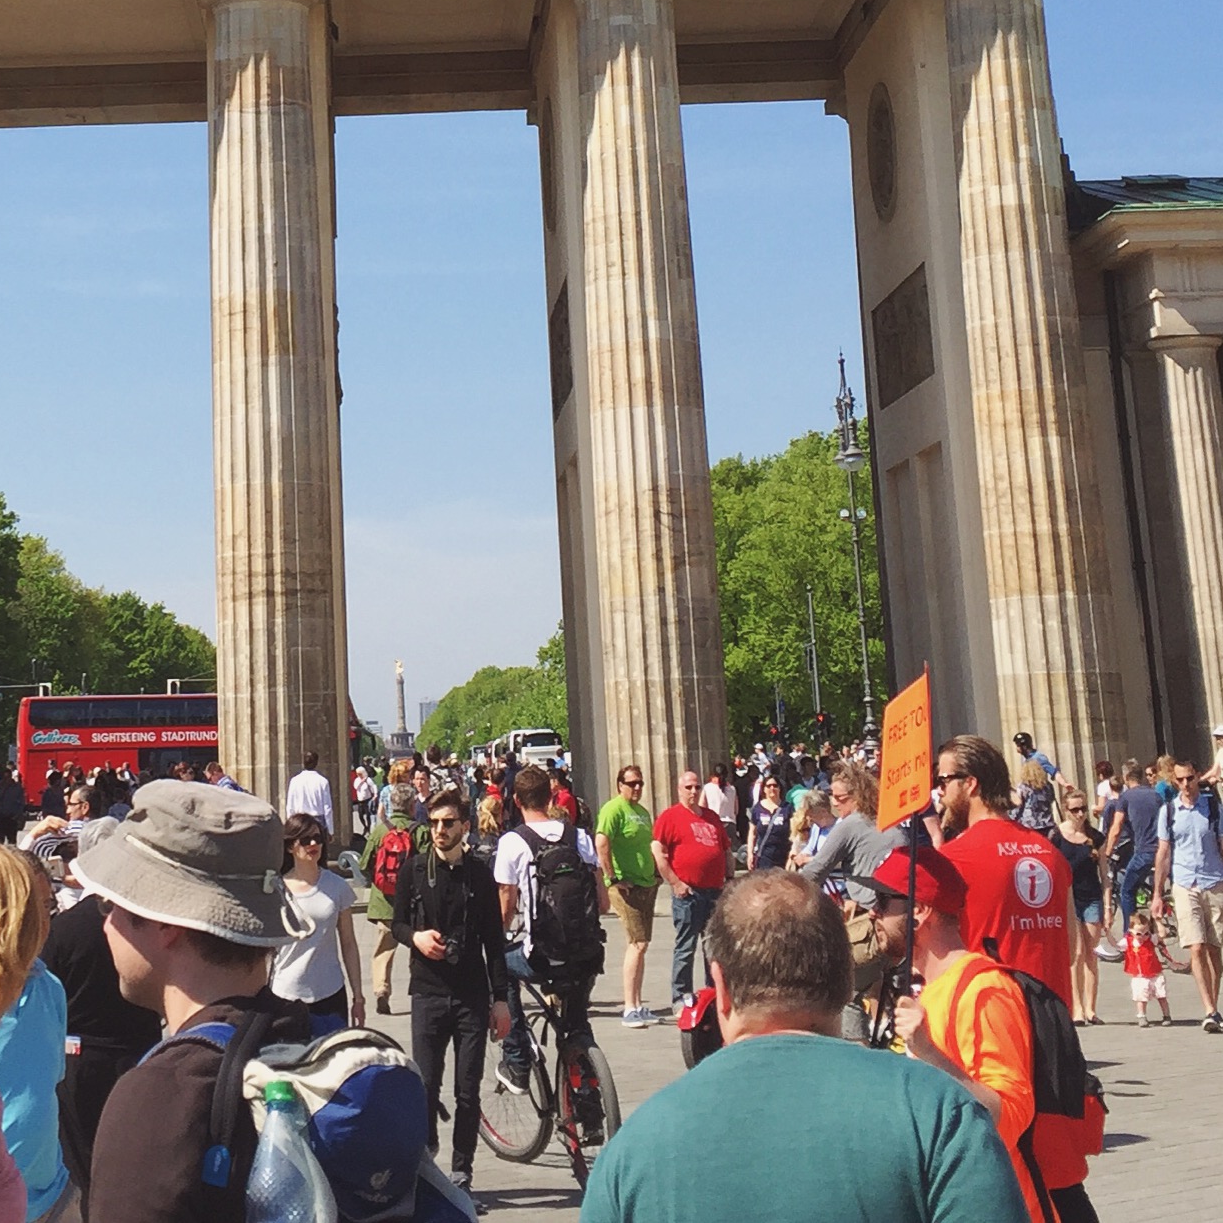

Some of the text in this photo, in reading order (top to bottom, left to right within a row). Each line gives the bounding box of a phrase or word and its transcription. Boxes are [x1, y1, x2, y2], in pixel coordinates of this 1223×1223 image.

[91, 732, 157, 743] SIGHTSEEING
[888, 714, 908, 748] FREE
[886, 759, 912, 790] Starts
